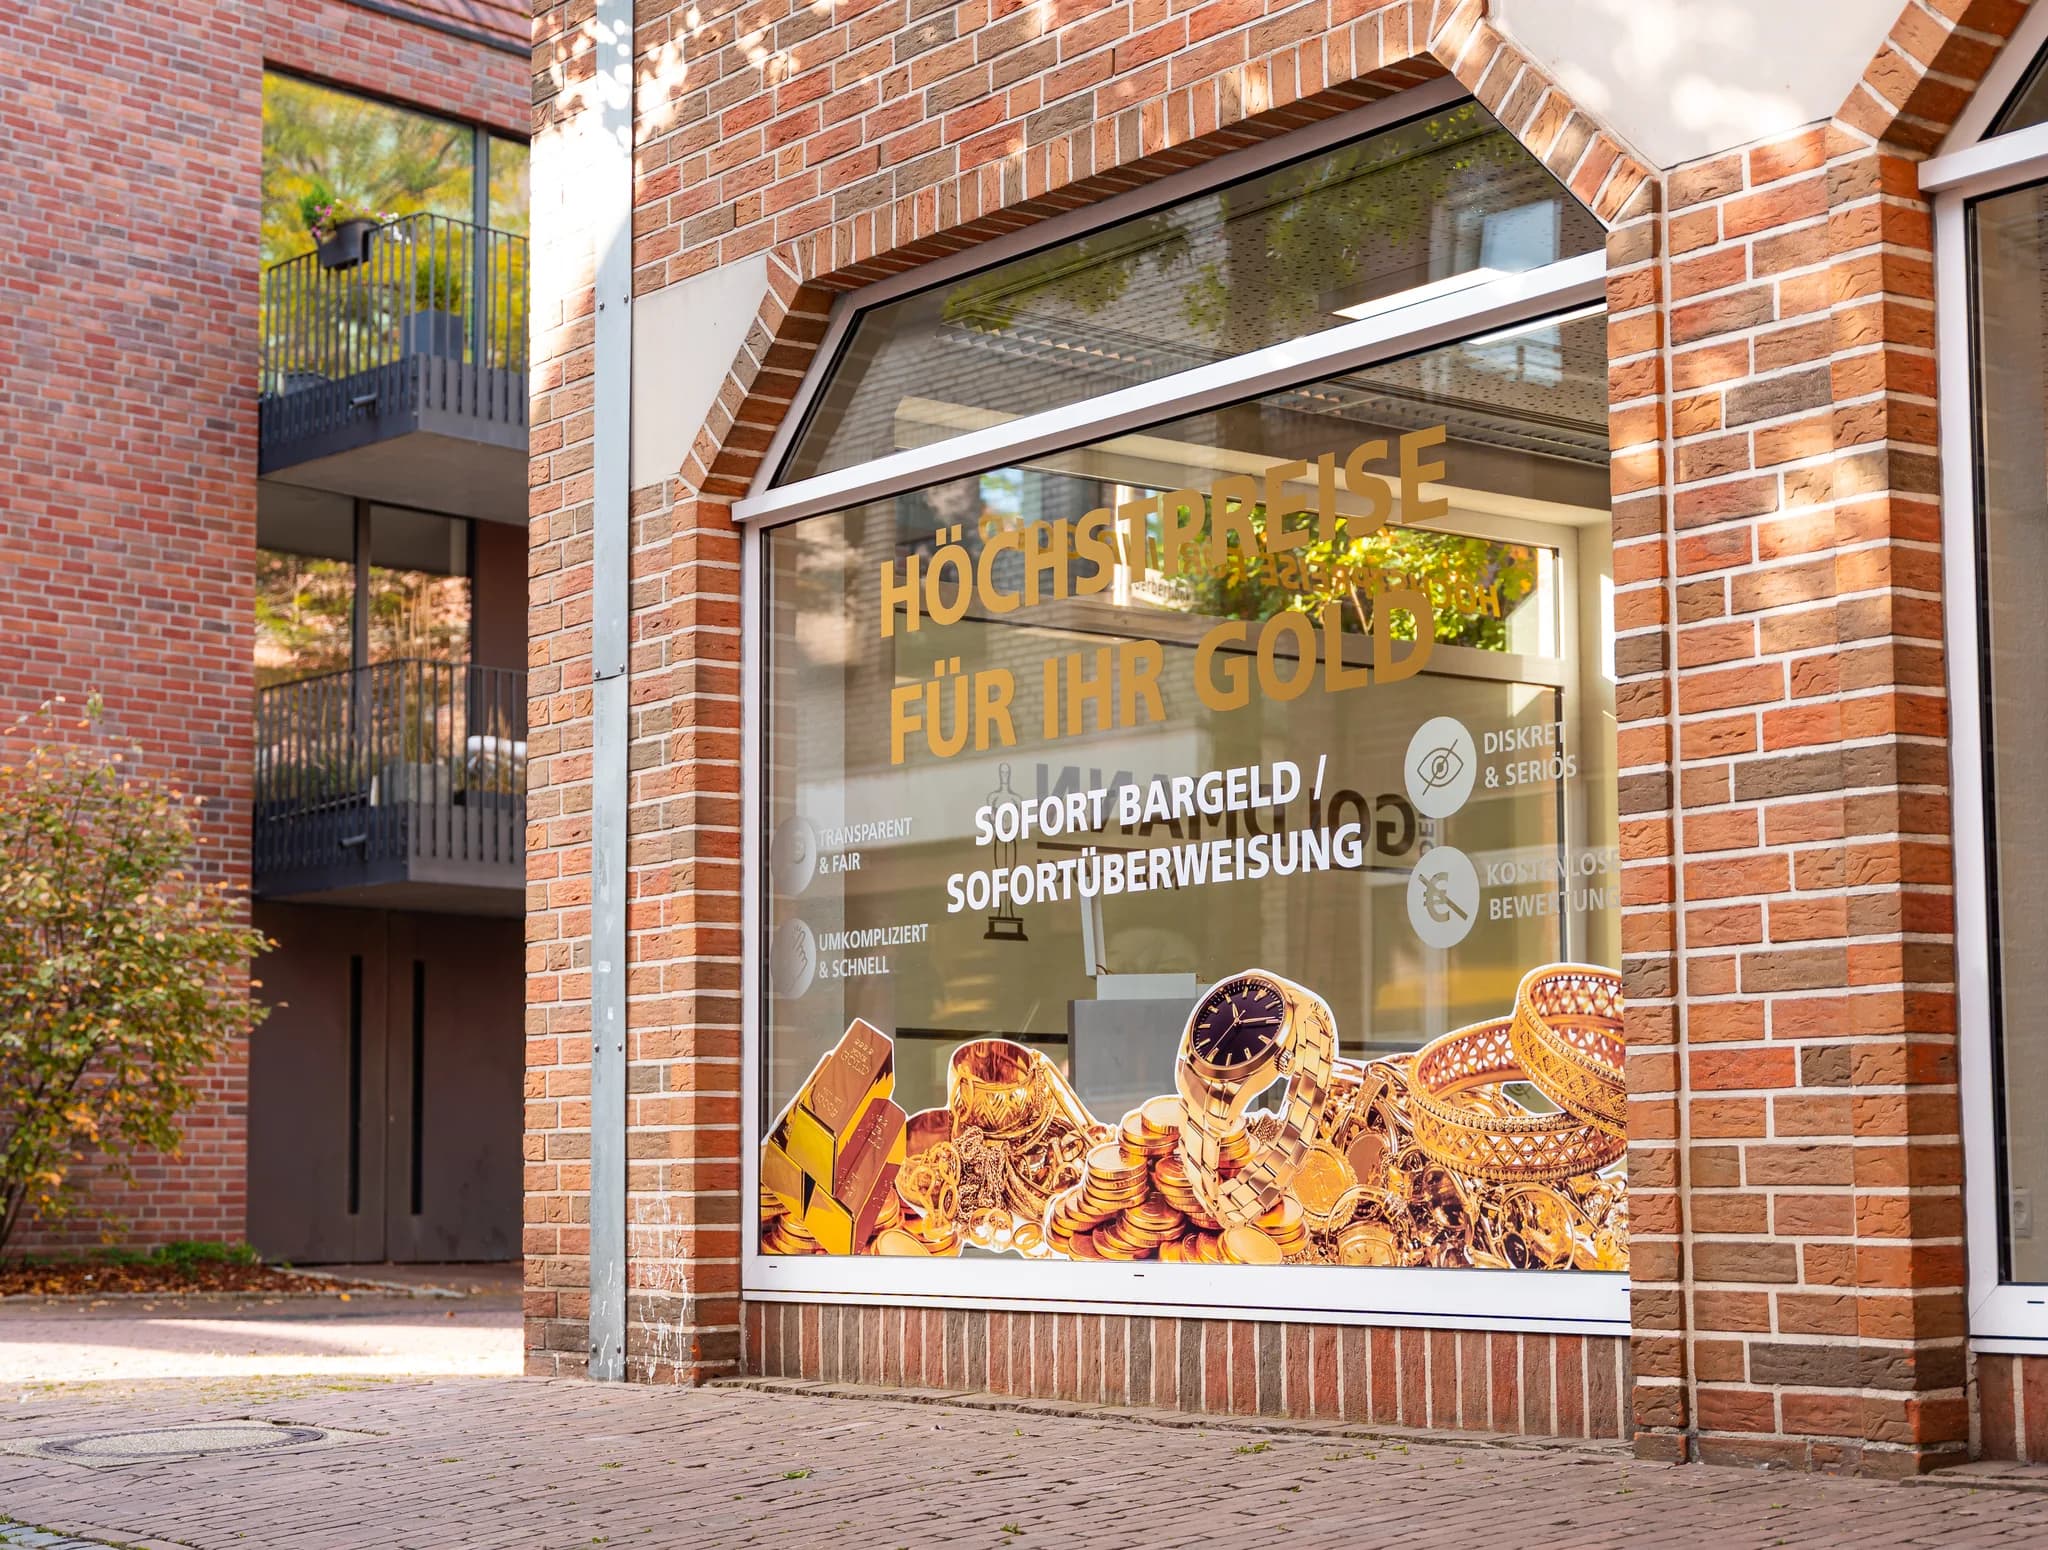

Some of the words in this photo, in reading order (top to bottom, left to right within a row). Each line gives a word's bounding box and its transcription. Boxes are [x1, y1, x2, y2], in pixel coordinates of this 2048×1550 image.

[881, 424, 1448, 638] HÖCHSTPREISE
[890, 656, 1017, 765] FÜR
[1043, 639, 1167, 740] IHR
[1194, 590, 1435, 711] GOLD
[1484, 721, 1568, 754] DISKRET
[1484, 767, 1499, 788] &
[1505, 752, 1577, 786] SERIÖS
[974, 789, 1108, 847] SOFORT
[1119, 760, 1301, 825] BARGELD
[1313, 754, 1327, 800] /
[819, 817, 913, 847] TRANSPARENT
[818, 857, 829, 874] &
[832, 853, 861, 873] FAIR
[946, 823, 1363, 913] SOFORTÜBERWEISUNG
[819, 924, 929, 952] UMKOMPLIZIERT
[818, 961, 829, 978] &
[832, 956, 890, 978] SCHNELL
